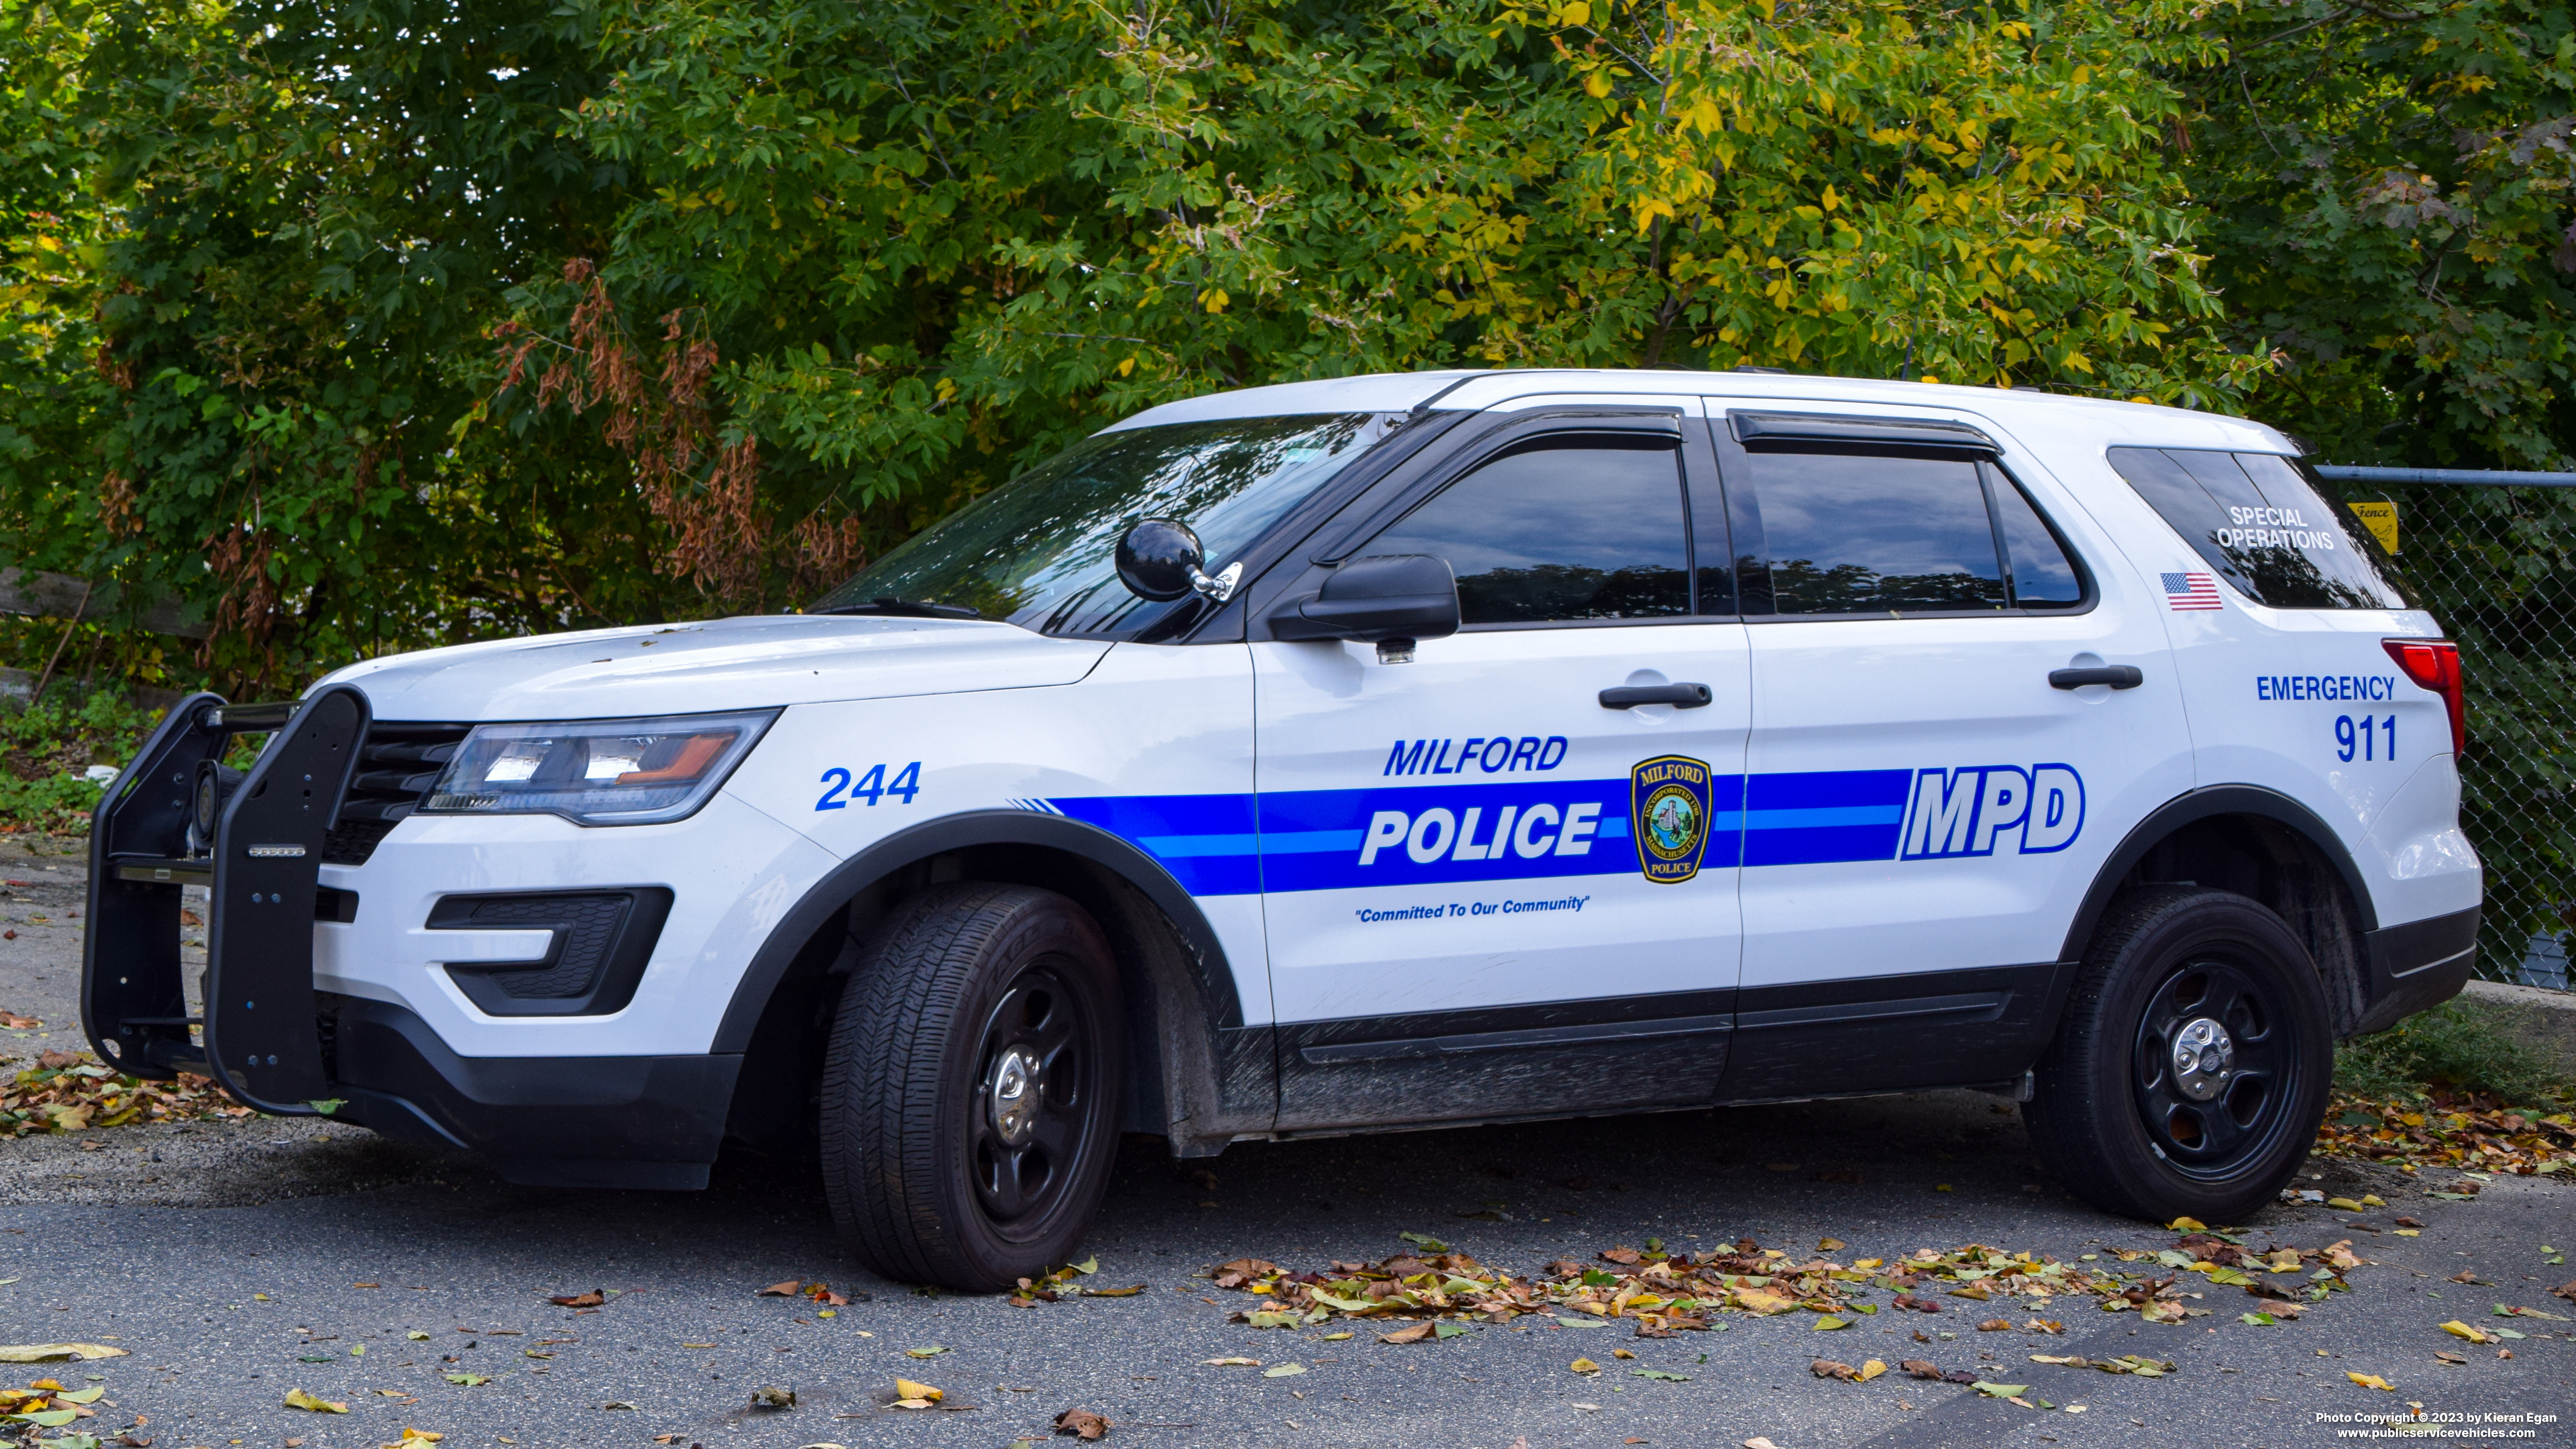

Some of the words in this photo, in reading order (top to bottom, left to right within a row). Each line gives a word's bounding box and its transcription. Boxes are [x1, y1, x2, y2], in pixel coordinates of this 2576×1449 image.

[2230, 506, 2308, 528] SPECIAL
[2357, 505, 2389, 517] Fence
[2217, 528, 2335, 550] OPERATIONS
[2256, 675, 2395, 700] EMERGENCY
[2335, 714, 2396, 762] 911
[1383, 735, 1569, 777] MILFORD
[815, 761, 922, 811] 244
[1640, 764, 1704, 786] MILFORD
[1645, 787, 1692, 818] INCORPORATED
[1690, 798, 1700, 816] 1780
[1900, 762, 2086, 861] MPD
[1359, 802, 1602, 865] POLICE
[1645, 834, 1698, 858] MASSACHUSETTS
[1651, 863, 1692, 874] POLICE
[1355, 904, 1444, 923] "Committed
[1449, 903, 1467, 917] To
[1471, 901, 1499, 916] Our
[1502, 895, 1591, 914] Community"
